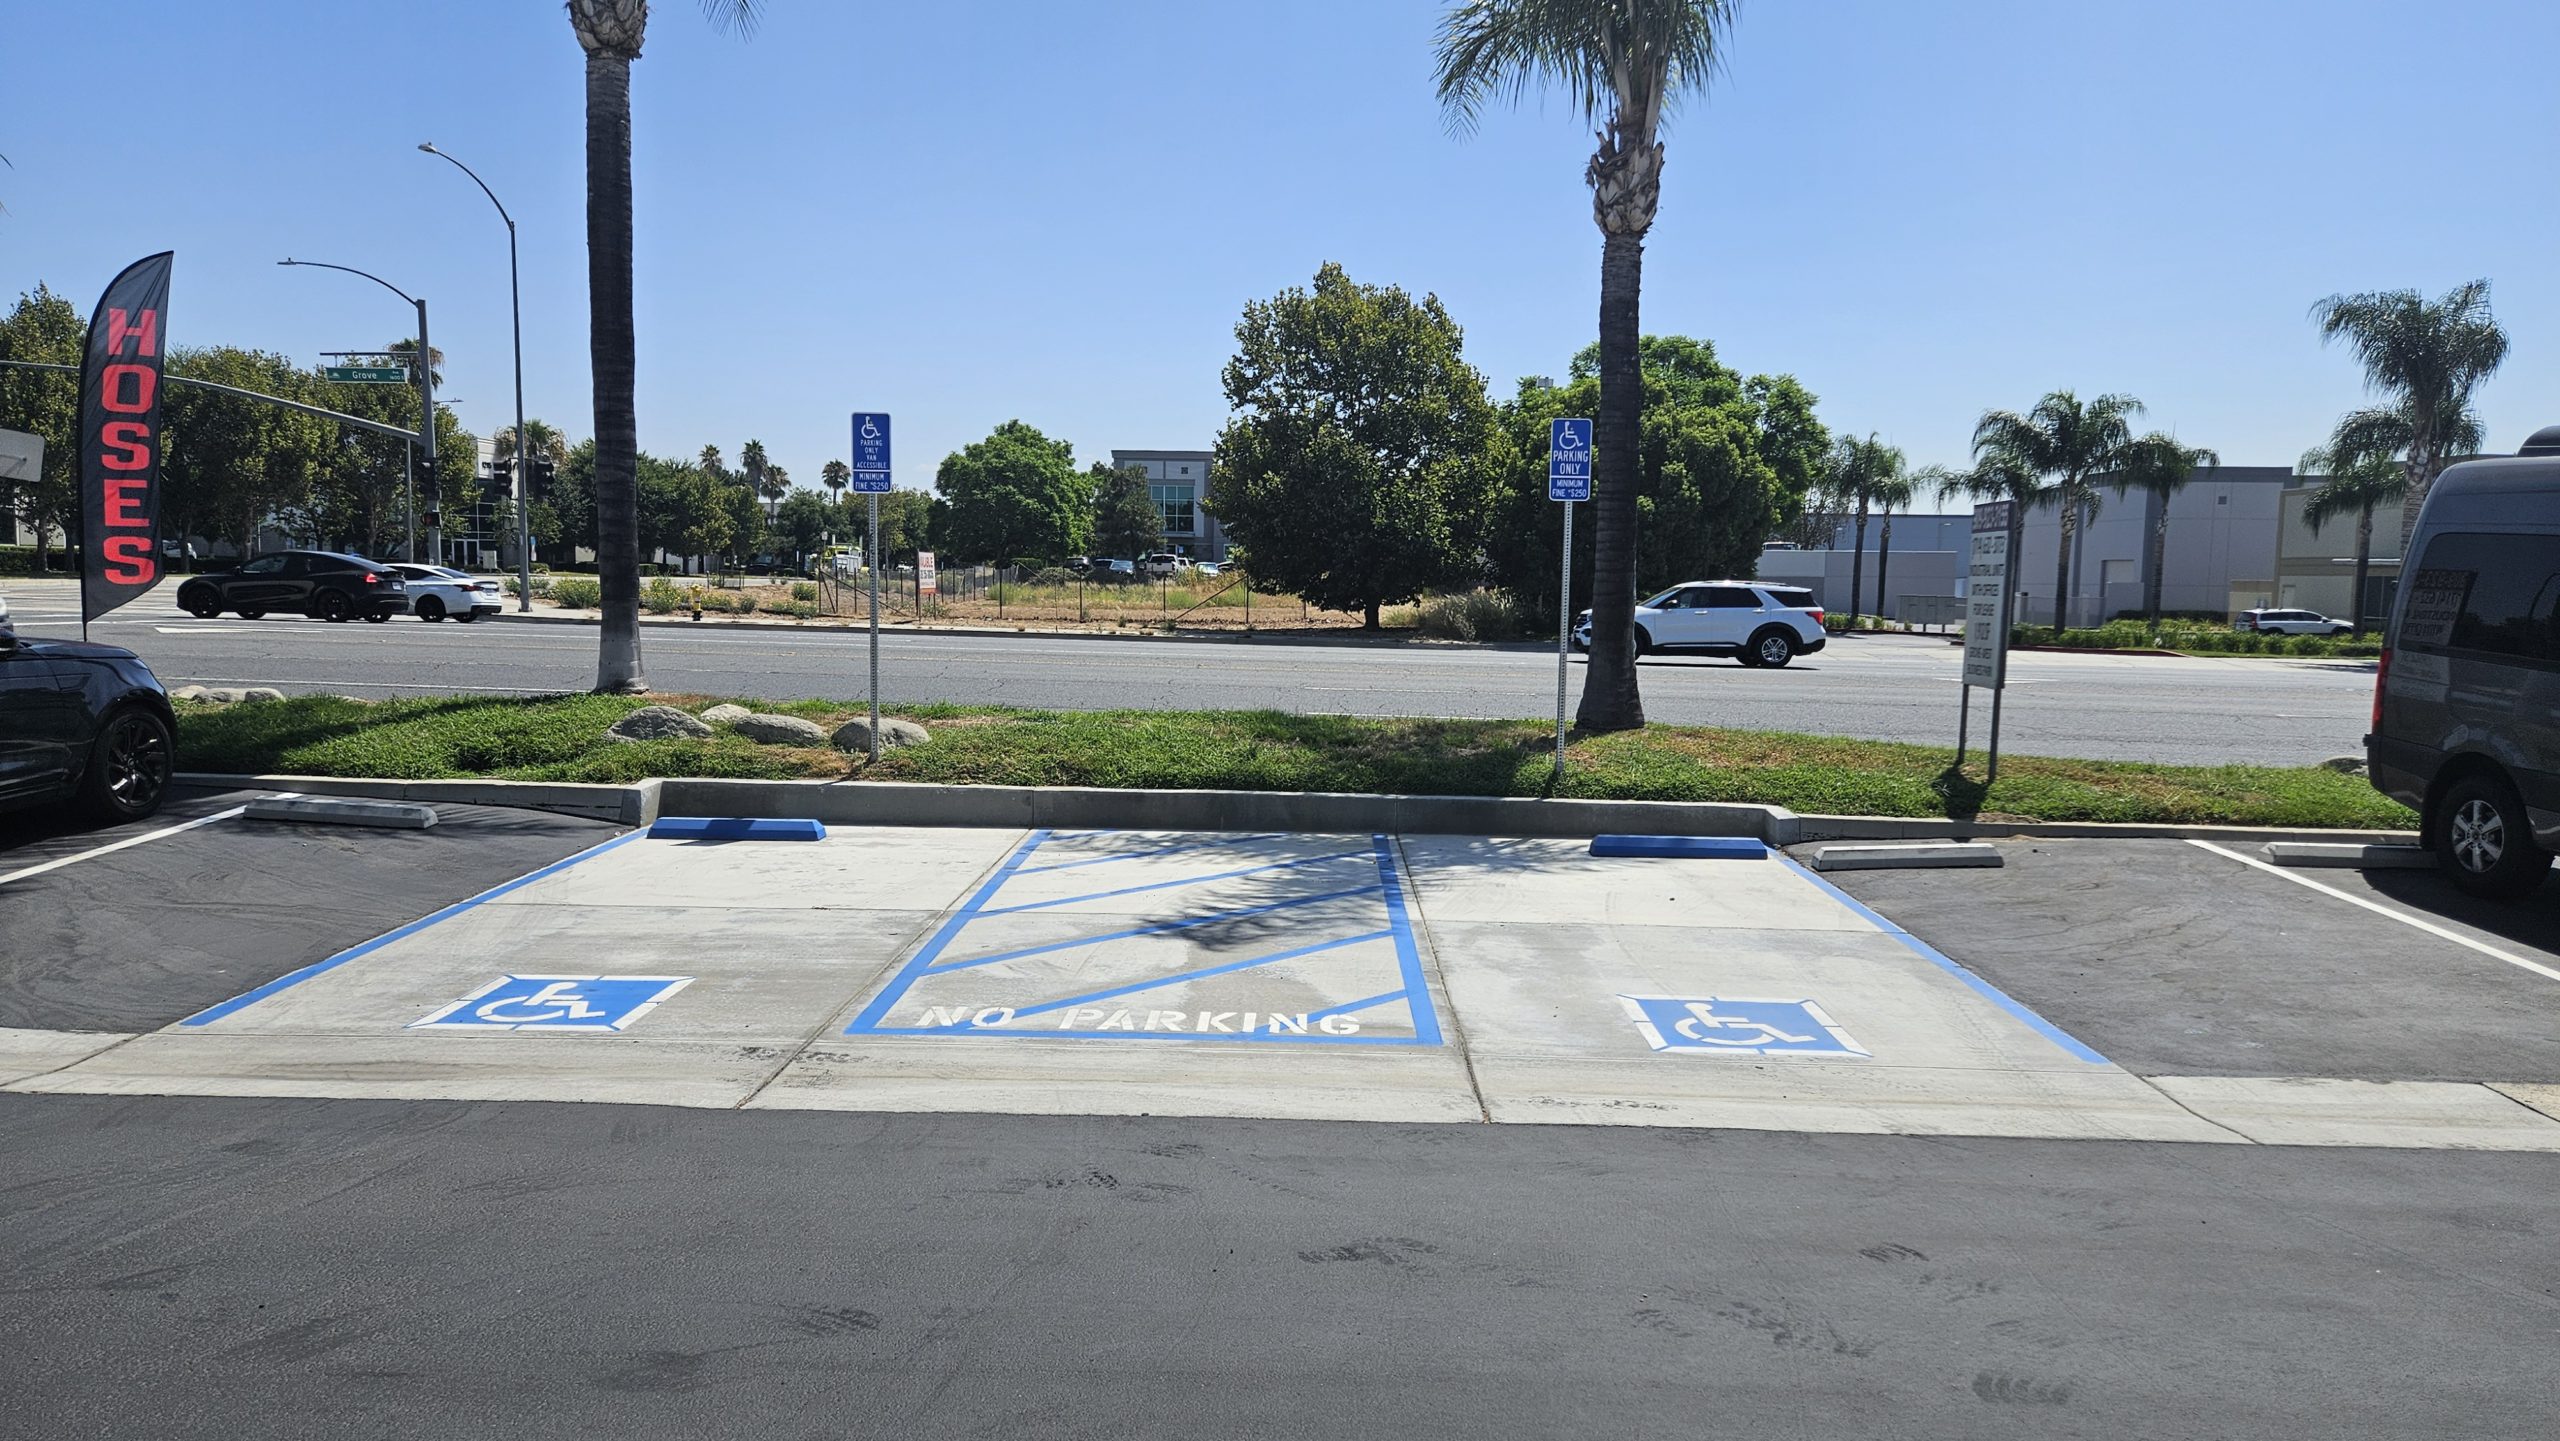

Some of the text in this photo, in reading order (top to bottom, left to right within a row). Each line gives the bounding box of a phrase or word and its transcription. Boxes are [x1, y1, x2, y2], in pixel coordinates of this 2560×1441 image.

[352, 370, 377, 380] Grove
[101, 307, 157, 586] HOSES
[860, 439, 883, 447] PARKING
[1553, 450, 1588, 462] PARKING
[856, 461, 887, 469] ACCESSIBLE
[1559, 463, 1581, 475] ONLY
[859, 473, 885, 481] MINIMUM
[855, 482, 868, 490] FINE
[1556, 479, 1583, 487] MINIMUM
[1552, 488, 1566, 497] FINE
[915, 1006, 1360, 1035] NO PARKING
